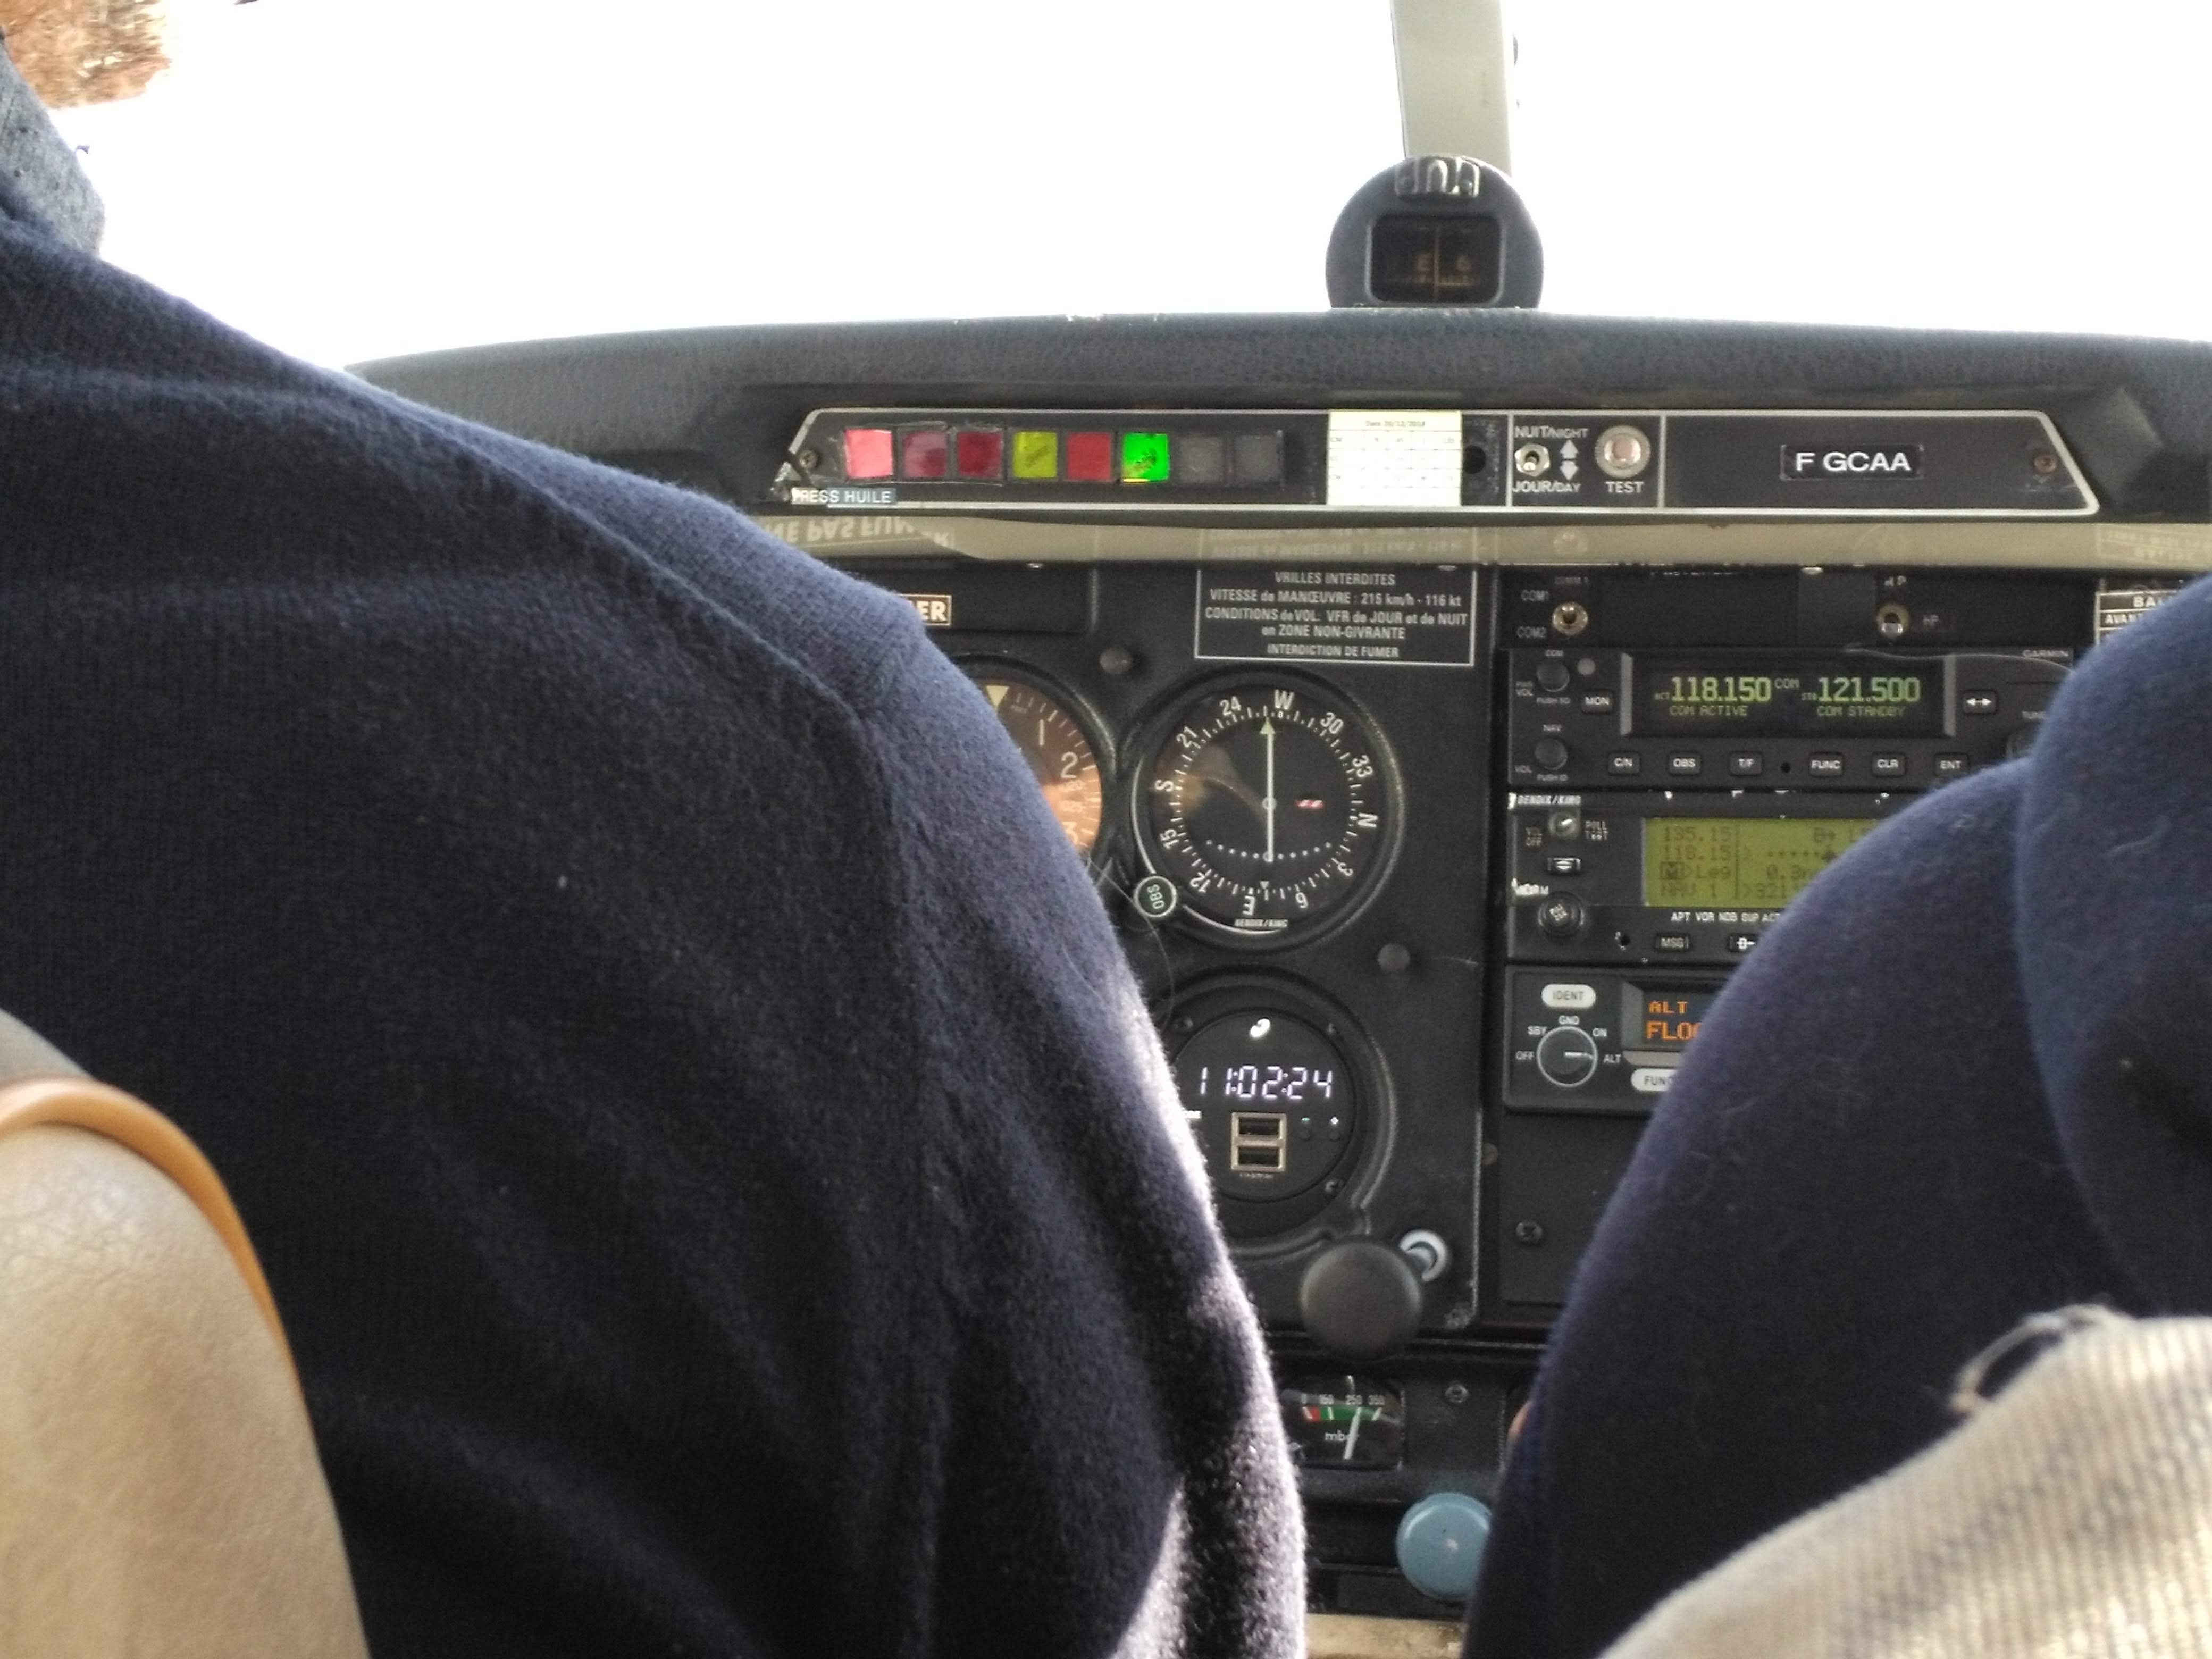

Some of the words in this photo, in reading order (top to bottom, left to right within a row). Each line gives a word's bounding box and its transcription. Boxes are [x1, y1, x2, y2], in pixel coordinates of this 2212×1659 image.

[1796, 452, 1815, 471] F
[1823, 451, 1912, 472] GCAA
[1512, 481, 1581, 493] JOUR/DAY
[1605, 481, 1644, 493] TEST
[844, 490, 892, 504] HUILE
[1275, 571, 1322, 584] VRILLES
[1325, 572, 1396, 586] INTERDITES
[1210, 588, 1259, 602] VITESSE
[1261, 591, 1276, 602] de
[1361, 592, 1382, 605] 215
[1385, 592, 1415, 606] km/h
[1426, 593, 1447, 607] 116
[1448, 594, 1462, 607] kt
[1204, 607, 1279, 621] CONDITIONS
[1280, 610, 1294, 621] de
[1326, 610, 1350, 623] VFR
[1352, 611, 1367, 623] de
[1369, 611, 1403, 624] JOUR
[1405, 614, 1418, 624] et
[1420, 612, 1435, 625] de
[1437, 613, 1468, 625] NUIT
[1261, 626, 1276, 636] en
[1278, 624, 1311, 636] ZONE
[1313, 625, 1406, 639] NON-GIVRANTE
[1516, 626, 1546, 638] COM2
[1267, 643, 1342, 656] INTERDICTION
[1344, 646, 1358, 657] DE
[1361, 646, 1400, 658] FUMER
[1671, 676, 1772, 702] 118.150
[1774, 677, 1800, 689] COM
[1819, 676, 1921, 702] 121.500
[1219, 696, 1242, 716] 24
[1275, 689, 1295, 710] W
[1585, 696, 1610, 706] MON
[1670, 705, 1695, 716] COM
[1699, 705, 1749, 716] ACTIVE
[1816, 706, 1842, 716] COM
[1847, 706, 1906, 717] STANDBY
[1320, 711, 1344, 735] 30
[1543, 724, 1562, 732] NAV
[1176, 726, 1199, 748] 21
[1060, 751, 1079, 780] 2
[1352, 755, 1374, 778] 33
[1515, 765, 1532, 773] VOL
[1672, 758, 1696, 767] OBS
[1811, 759, 1841, 769] FUNC
[1876, 759, 1899, 768] CLR
[1940, 760, 1962, 769] ENT
[1154, 779, 1175, 793] S
[1357, 812, 1379, 828] N
[1159, 828, 1180, 850] 15
[1337, 861, 1354, 877] 3
[1189, 871, 1211, 894] 12
[1146, 883, 1166, 910] OBS
[1242, 895, 1256, 916] E
[1670, 911, 1691, 921] APT
[1695, 911, 1715, 922] VOR
[1718, 911, 1738, 922] NDB
[1741, 912, 1759, 923] SUP
[1661, 937, 1685, 949] MSG
[1552, 990, 1584, 1001] IDENT
[1649, 1000, 1688, 1014] ALT
[1592, 1027, 1608, 1037] ON
[1515, 1051, 1535, 1061] OFF
[1603, 1054, 1622, 1064] ALT
[1200, 1065, 1334, 1100] 11:02:24
